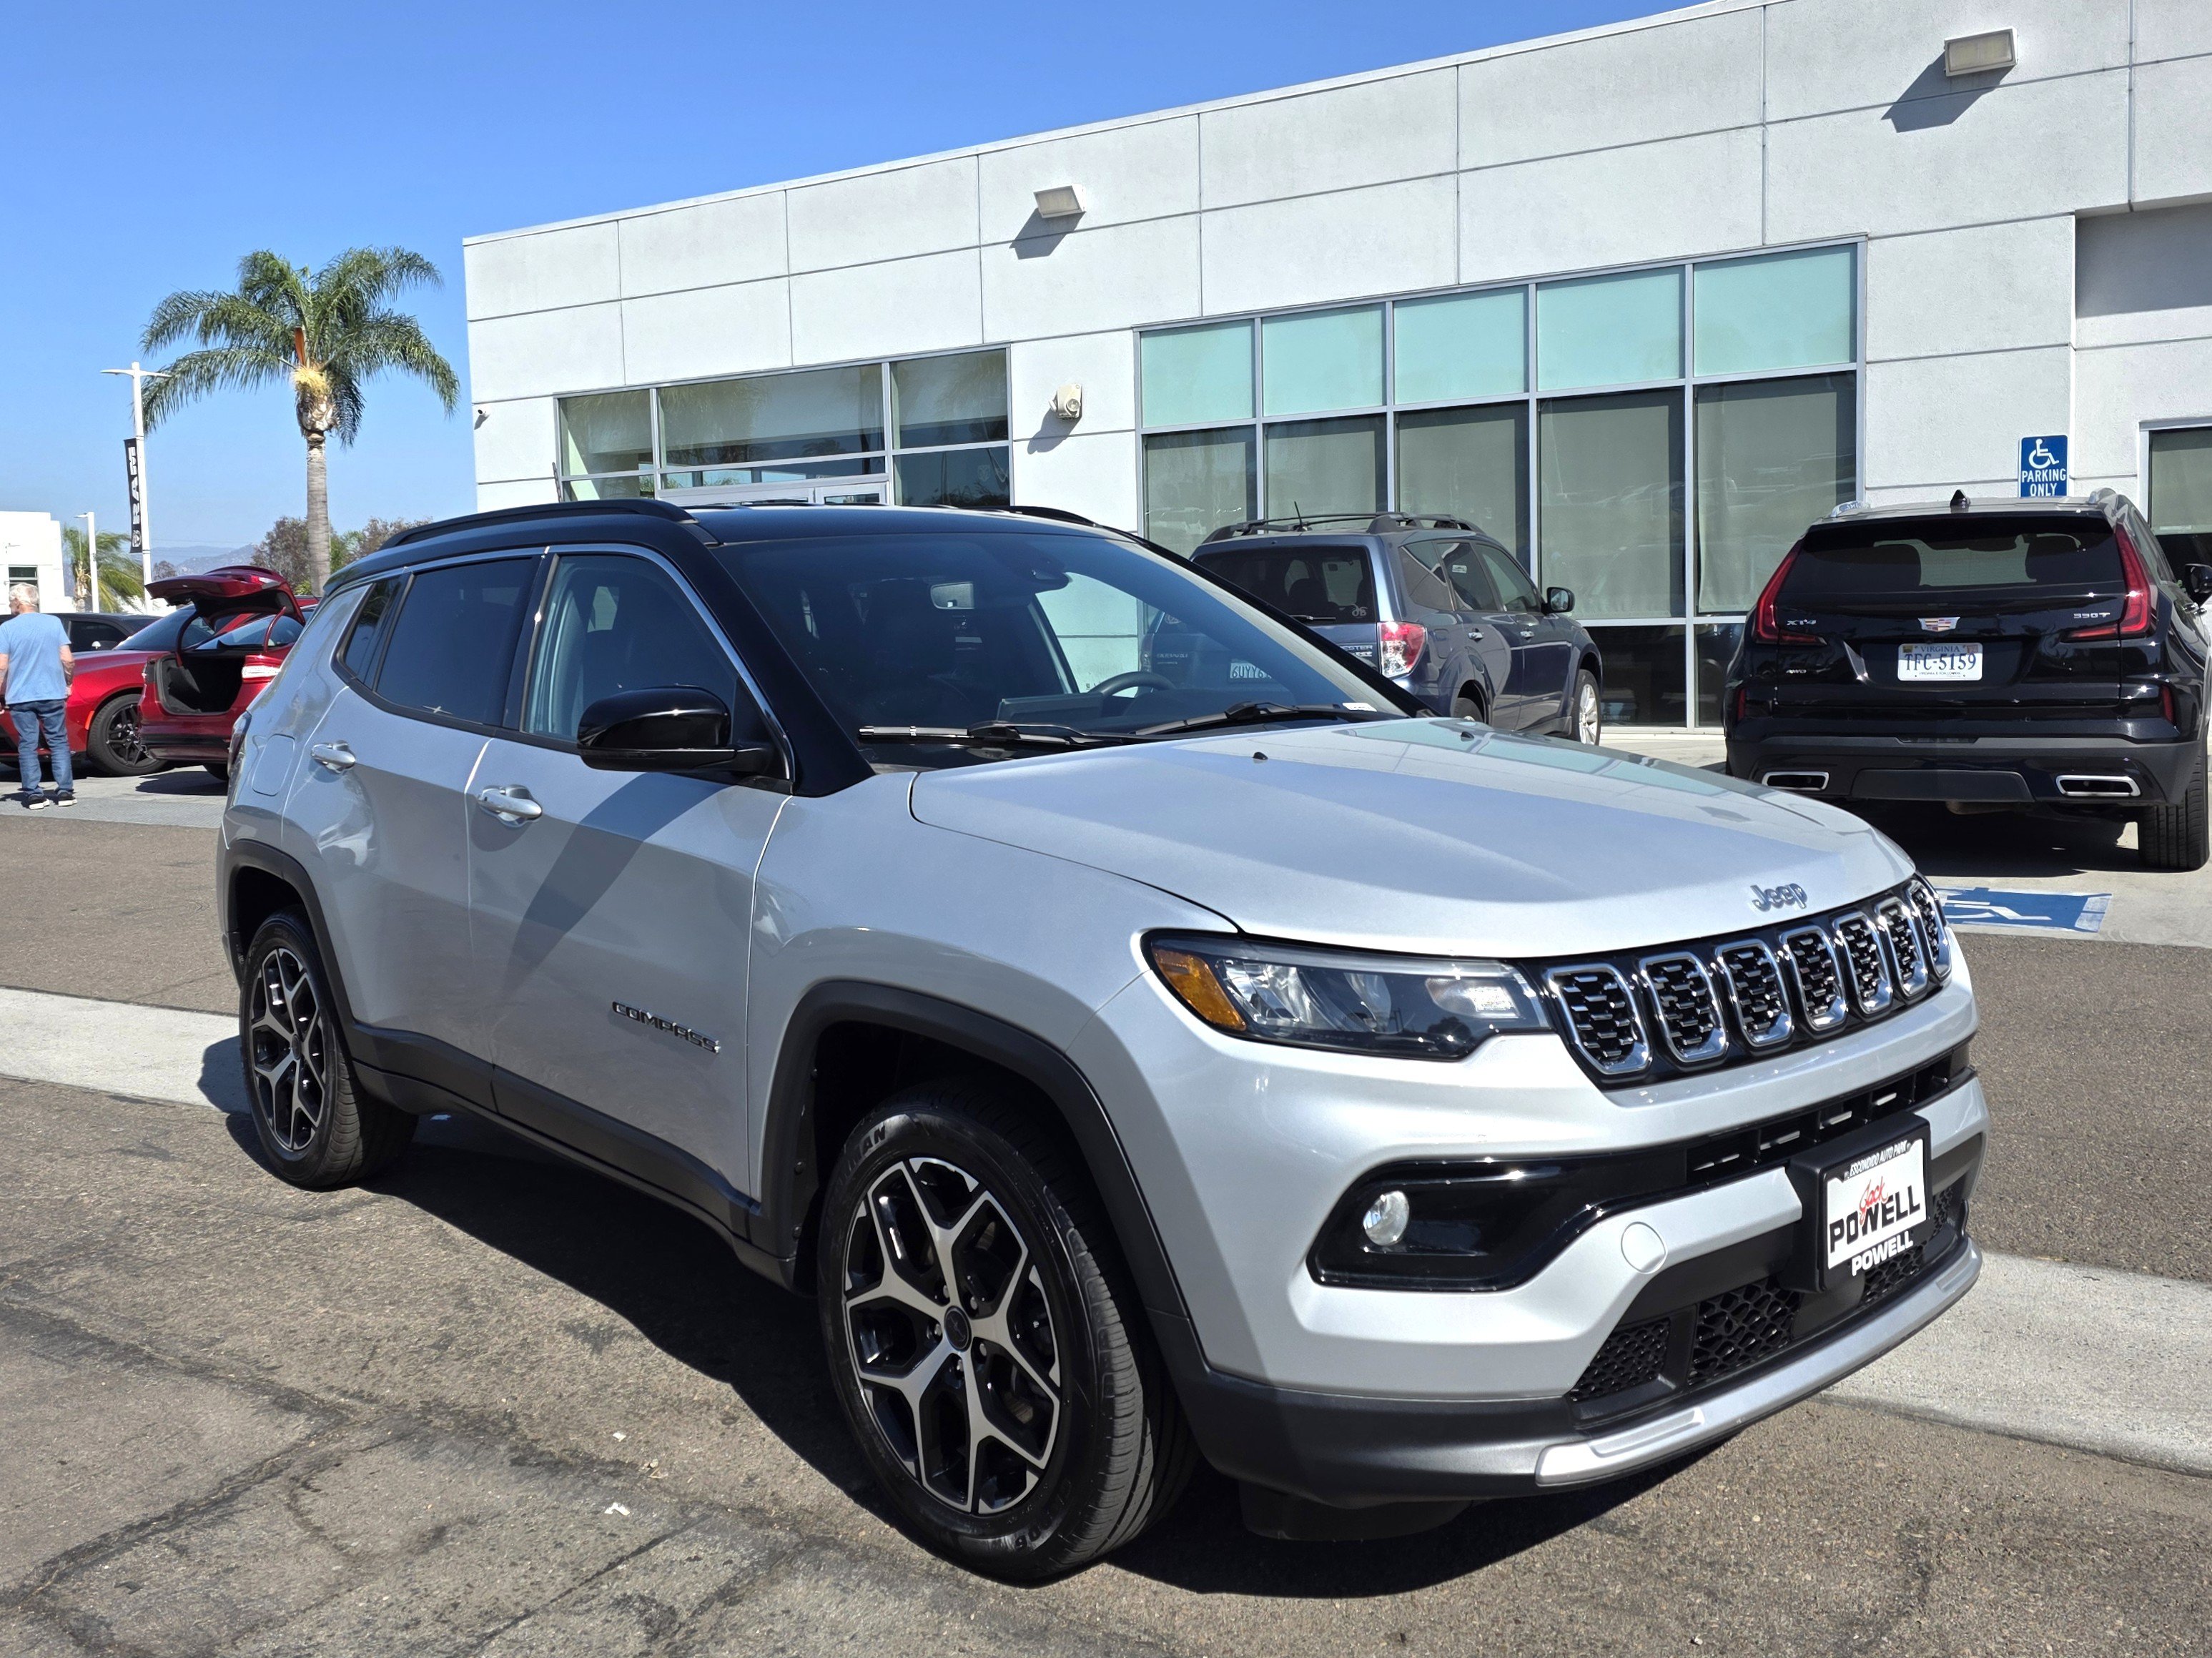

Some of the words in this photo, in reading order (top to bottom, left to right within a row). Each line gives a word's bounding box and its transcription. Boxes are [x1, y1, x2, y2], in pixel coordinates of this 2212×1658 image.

[128, 447, 140, 525] RAM
[2021, 468, 2067, 483] PARKING
[2030, 483, 2058, 497] ONLY
[1904, 652, 1977, 671] TFC-5159
[1749, 883, 1808, 912] Jeep
[612, 1001, 721, 1055] COMPASS
[1850, 1152, 1880, 1177] ESCONDIDO
[1879, 1146, 1894, 1164] AUTO
[1893, 1140, 1907, 1157] PARK
[1830, 1185, 1920, 1254] POWELL
[1859, 1175, 1889, 1227] Jack
[1852, 1230, 1914, 1277] POWELL
